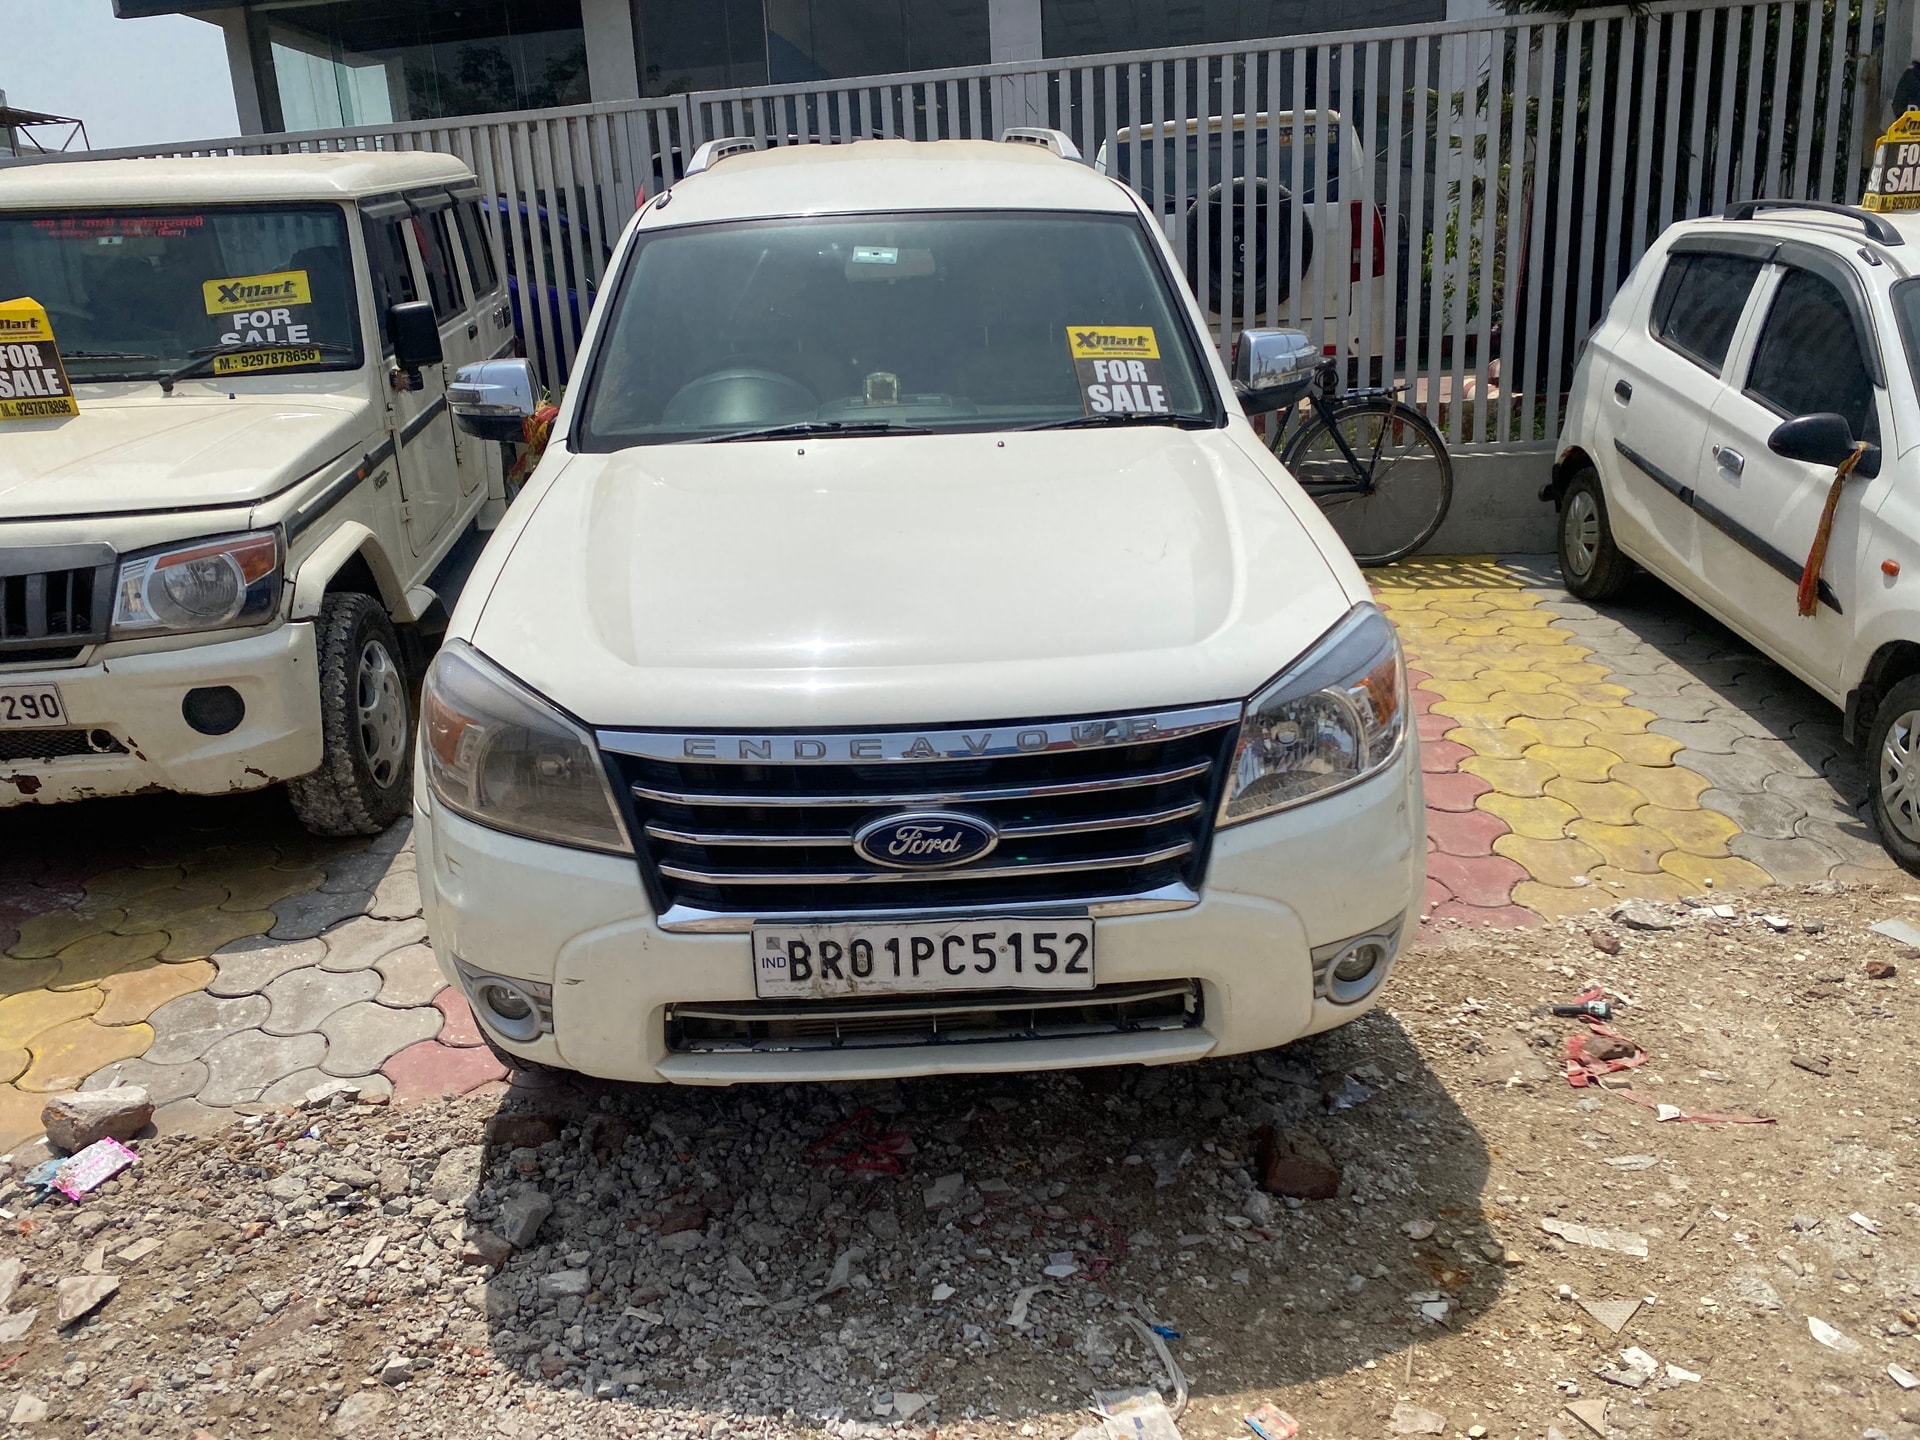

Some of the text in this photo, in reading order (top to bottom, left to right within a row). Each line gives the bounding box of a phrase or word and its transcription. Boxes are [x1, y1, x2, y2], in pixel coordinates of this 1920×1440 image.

[1897, 143, 1920, 166] FO
[217, 280, 297, 304] Xmart
[233, 308, 292, 330] FOR
[220, 324, 310, 346] SALE
[1075, 331, 1150, 349] Xmart
[241, 349, 316, 368] 9297878656
[0, 368, 64, 398] SALE
[1093, 359, 1149, 383] FOR
[1087, 384, 1169, 413] SALE
[1, 693, 60, 720] 290
[683, 717, 1160, 760] ENDEAVOUR
[888, 825, 963, 856] Ford
[762, 932, 1090, 983] IND BR01PC5152
